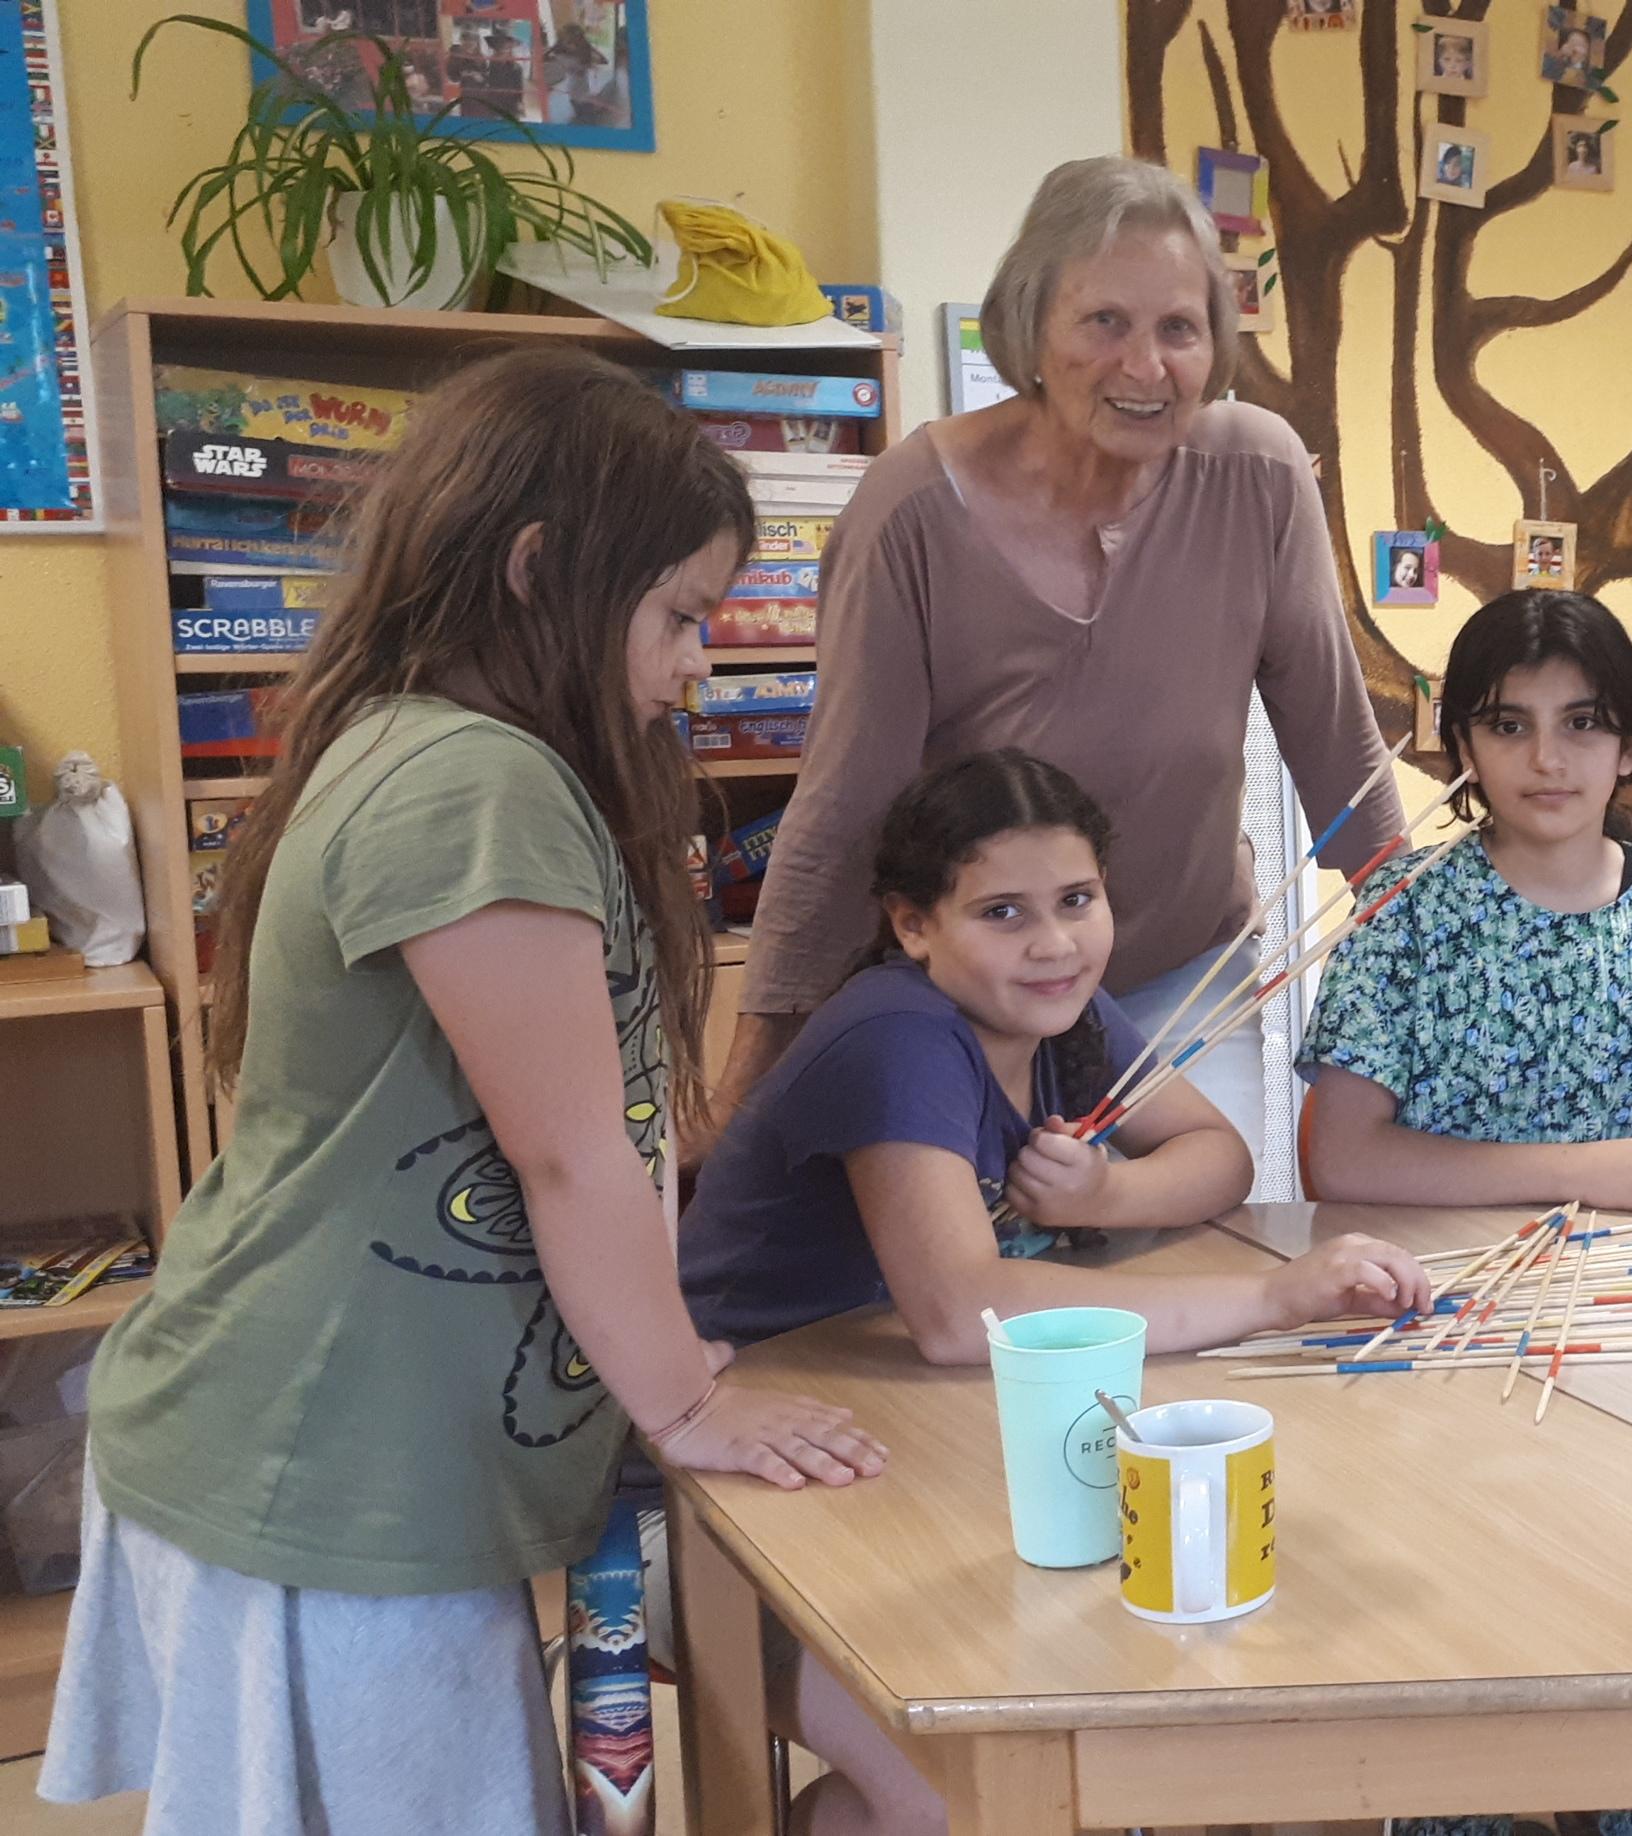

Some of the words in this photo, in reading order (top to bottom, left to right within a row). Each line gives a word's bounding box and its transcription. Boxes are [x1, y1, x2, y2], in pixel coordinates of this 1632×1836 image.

[193, 444, 267, 463] STAR
[193, 457, 268, 477] WARS
[176, 618, 315, 641] SCRABBLE
